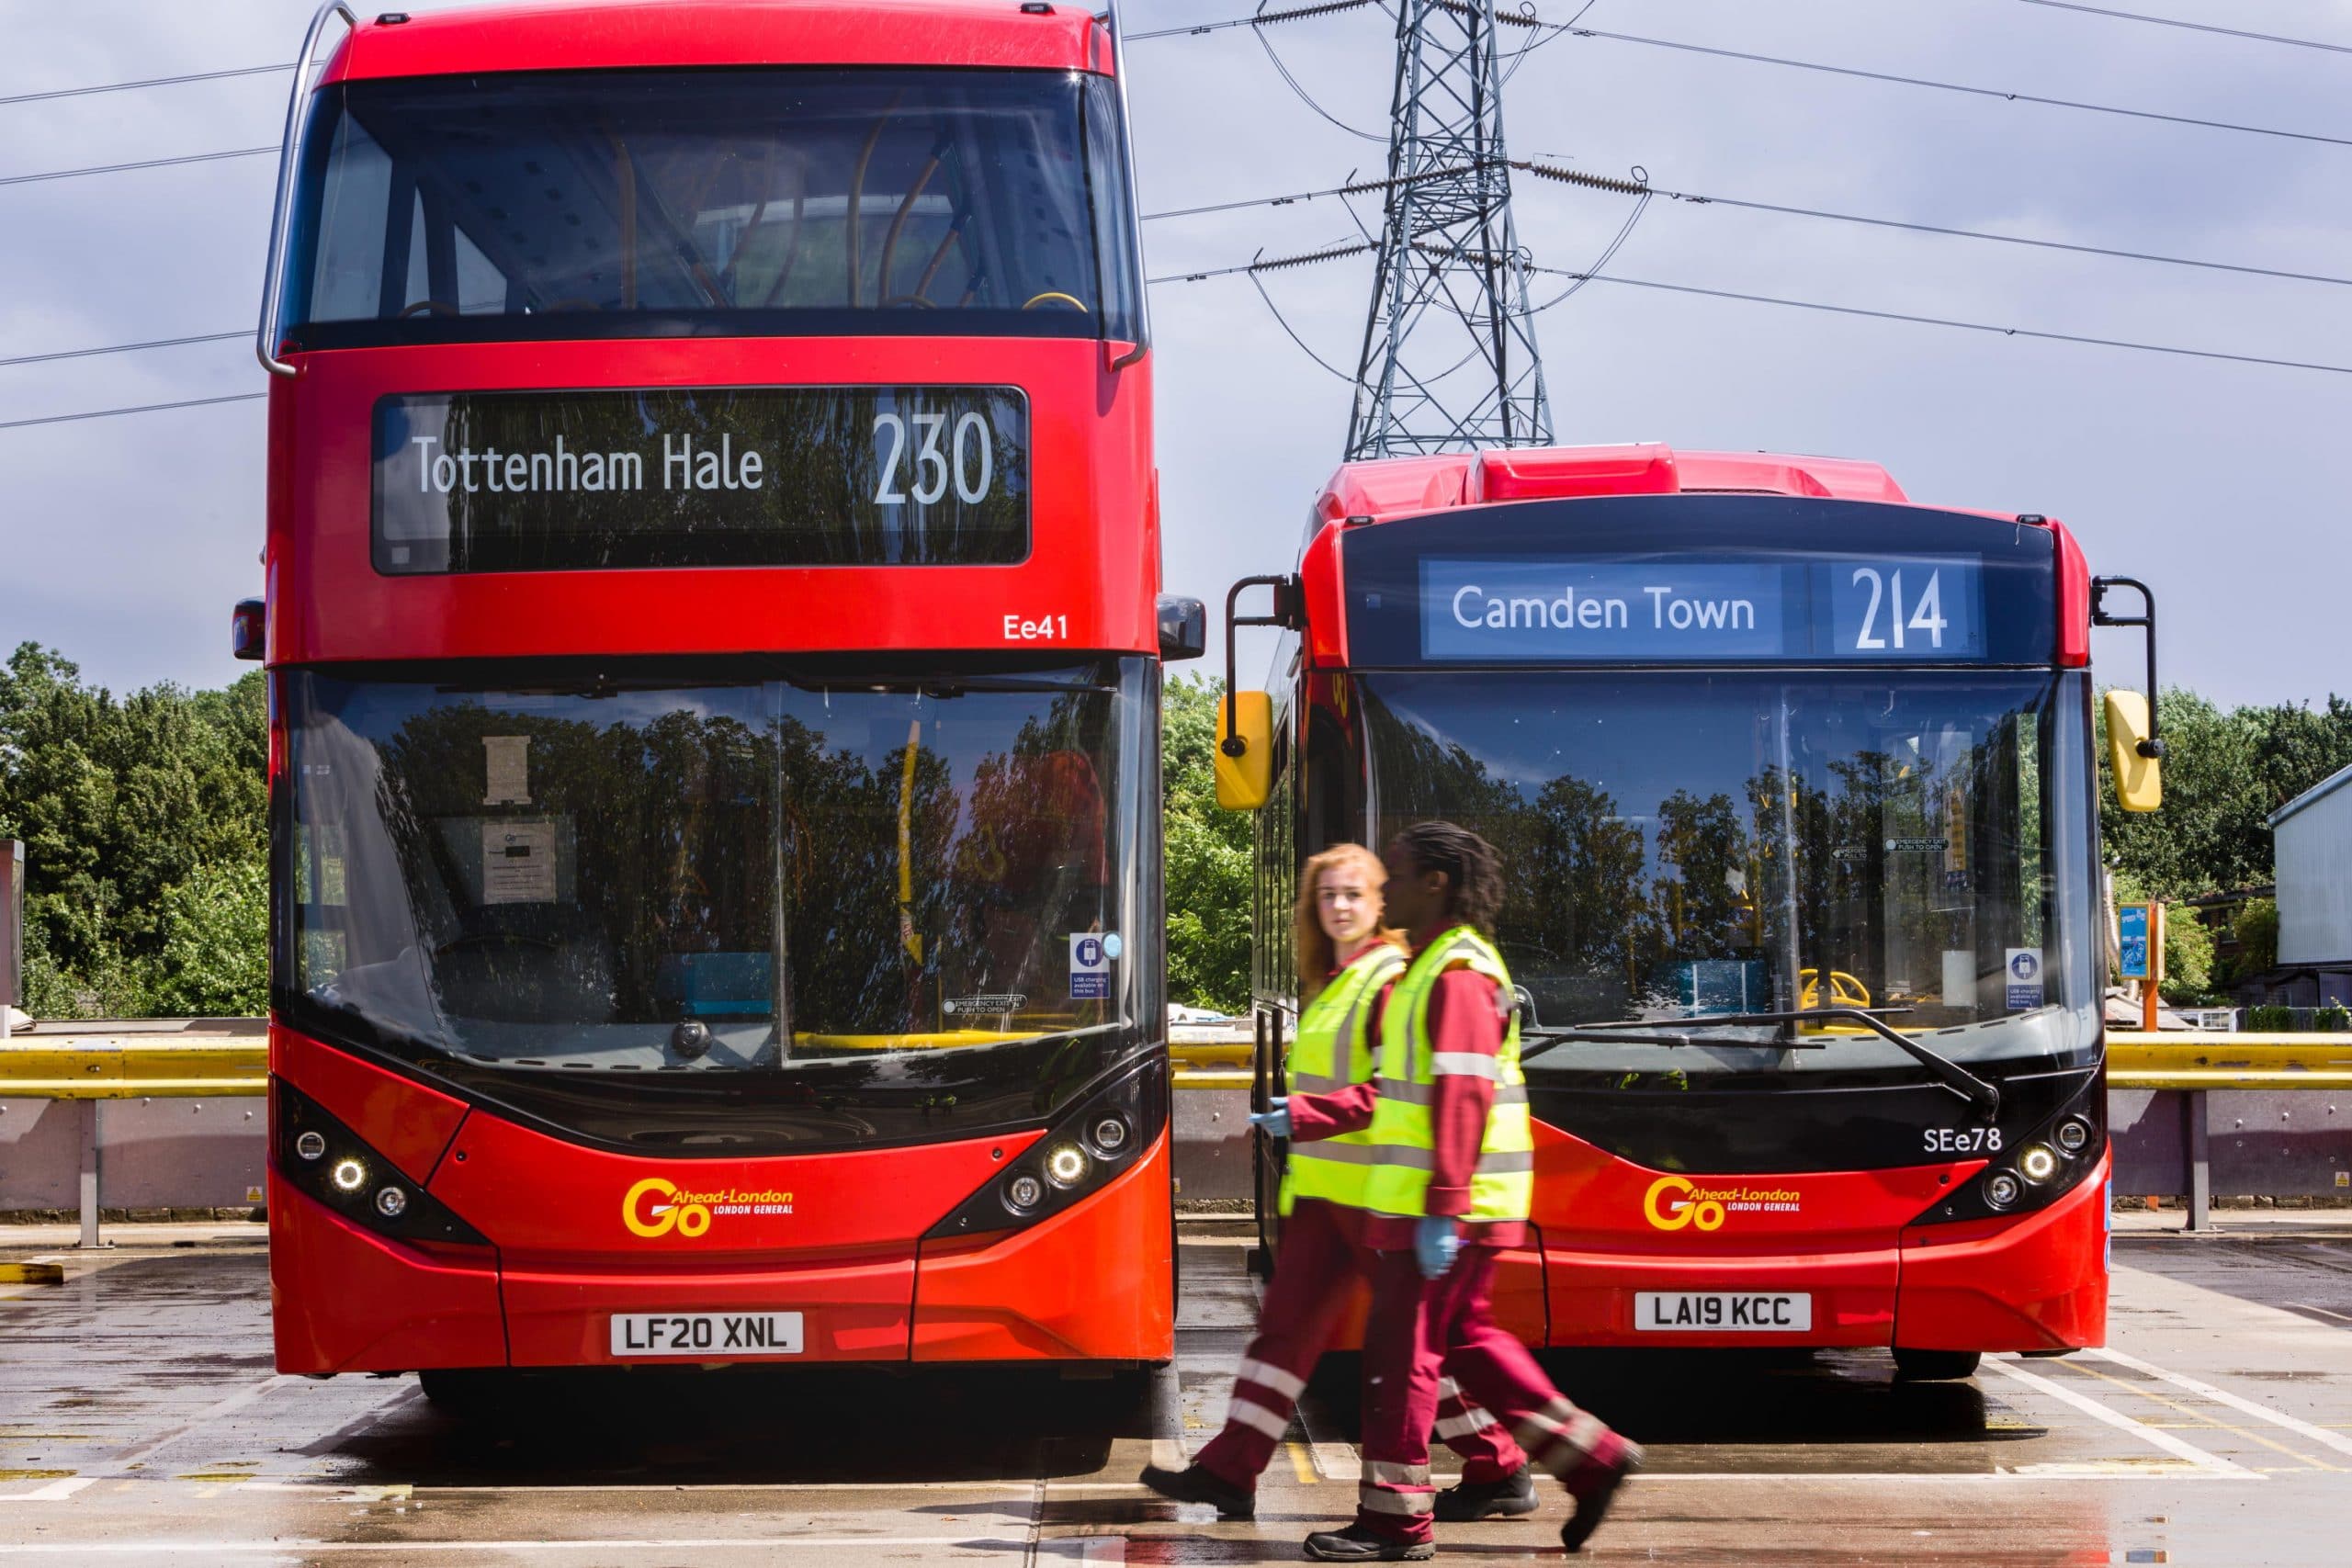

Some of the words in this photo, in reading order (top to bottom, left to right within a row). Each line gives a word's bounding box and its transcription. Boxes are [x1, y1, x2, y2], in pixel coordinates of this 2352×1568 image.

[411, 434, 642, 492] Tottenham
[663, 433, 763, 491] Hale
[873, 412, 993, 505] 230
[1453, 585, 1628, 628] Camden
[1643, 586, 1755, 629] Town
[1852, 568, 1948, 649] 214
[1003, 615, 1068, 640] Ee41
[1923, 1127, 2002, 1152] SEe78
[622, 1178, 711, 1237] Go
[672, 1189, 794, 1204] Ahead-London
[713, 1205, 751, 1215] LONDON
[753, 1204, 794, 1214] GENERAL
[1644, 1176, 1725, 1232] Go
[1689, 1188, 1800, 1201] Ahead-London
[1727, 1202, 1761, 1212] LONDON
[1764, 1202, 1800, 1212] GENERAL
[1655, 1296, 1723, 1325] LA19
[1732, 1296, 1791, 1325] KCC
[626, 1317, 712, 1348] LF20
[723, 1316, 787, 1348] XNL
